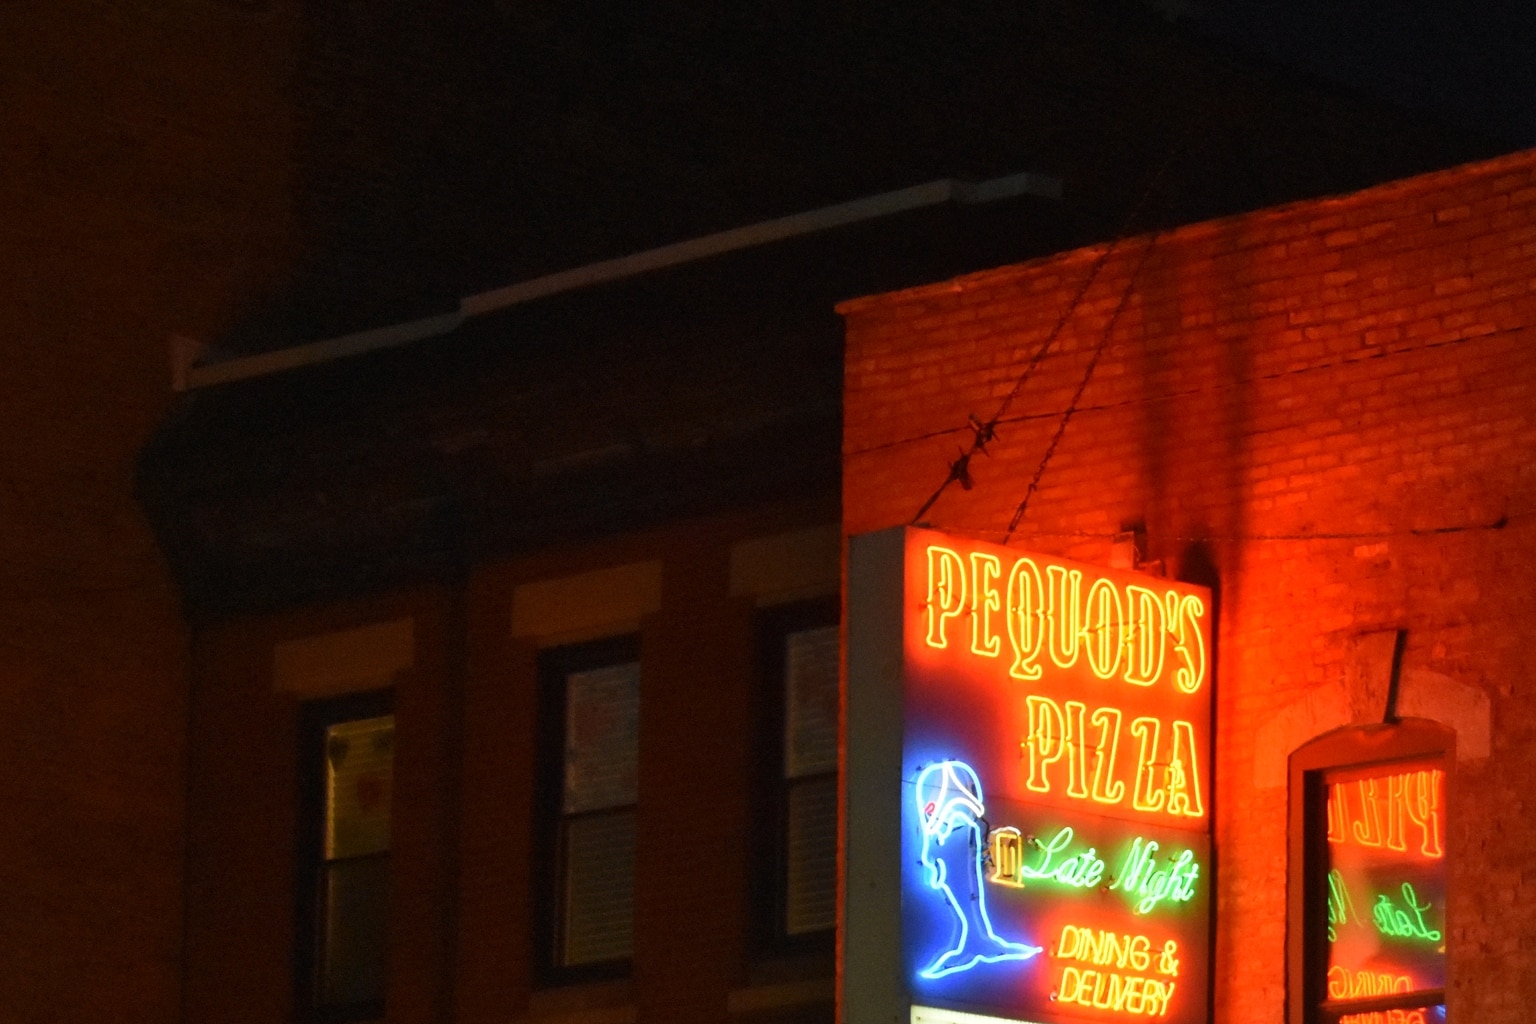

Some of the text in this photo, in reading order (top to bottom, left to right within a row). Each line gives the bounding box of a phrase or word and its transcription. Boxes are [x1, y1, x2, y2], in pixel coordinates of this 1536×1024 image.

[926, 545, 1206, 694] PEQUOD'S
[1024, 695, 1204, 818] PIZZA
[1022, 826, 1200, 915] Late Night
[1056, 966, 1175, 1017] DELIVERY
[1057, 925, 1179, 977] DINING &
